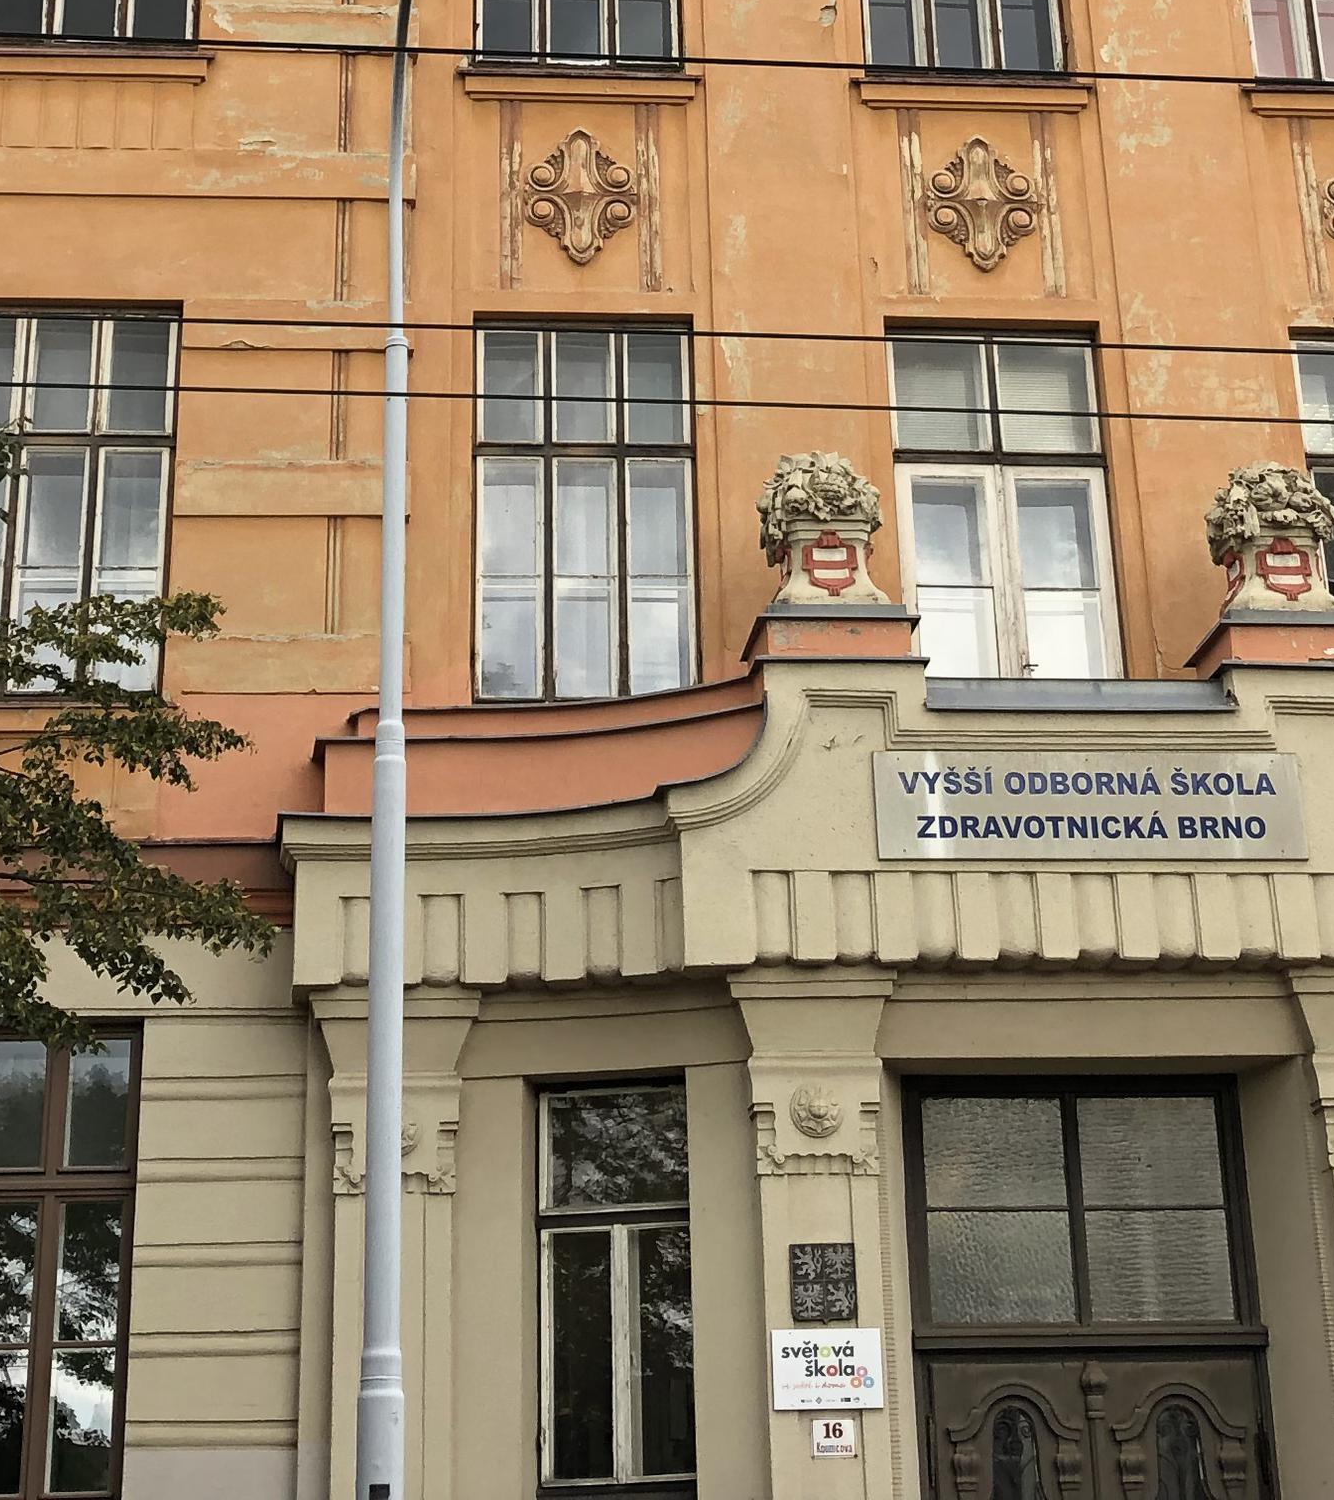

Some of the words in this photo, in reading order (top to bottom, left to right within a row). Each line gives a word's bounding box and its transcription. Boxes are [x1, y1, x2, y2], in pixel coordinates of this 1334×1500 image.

[898, 766, 993, 796] VYŠŠÍ
[1003, 767, 1162, 796] ODBORNÁ
[1170, 767, 1277, 796] ŠKOLA
[916, 811, 1169, 840] ZDRAVOTNICKÁ
[1178, 816, 1267, 840] BRNO
[781, 1340, 854, 1359] světová
[805, 1359, 855, 1377] škola
[823, 1422, 844, 1439] 16
